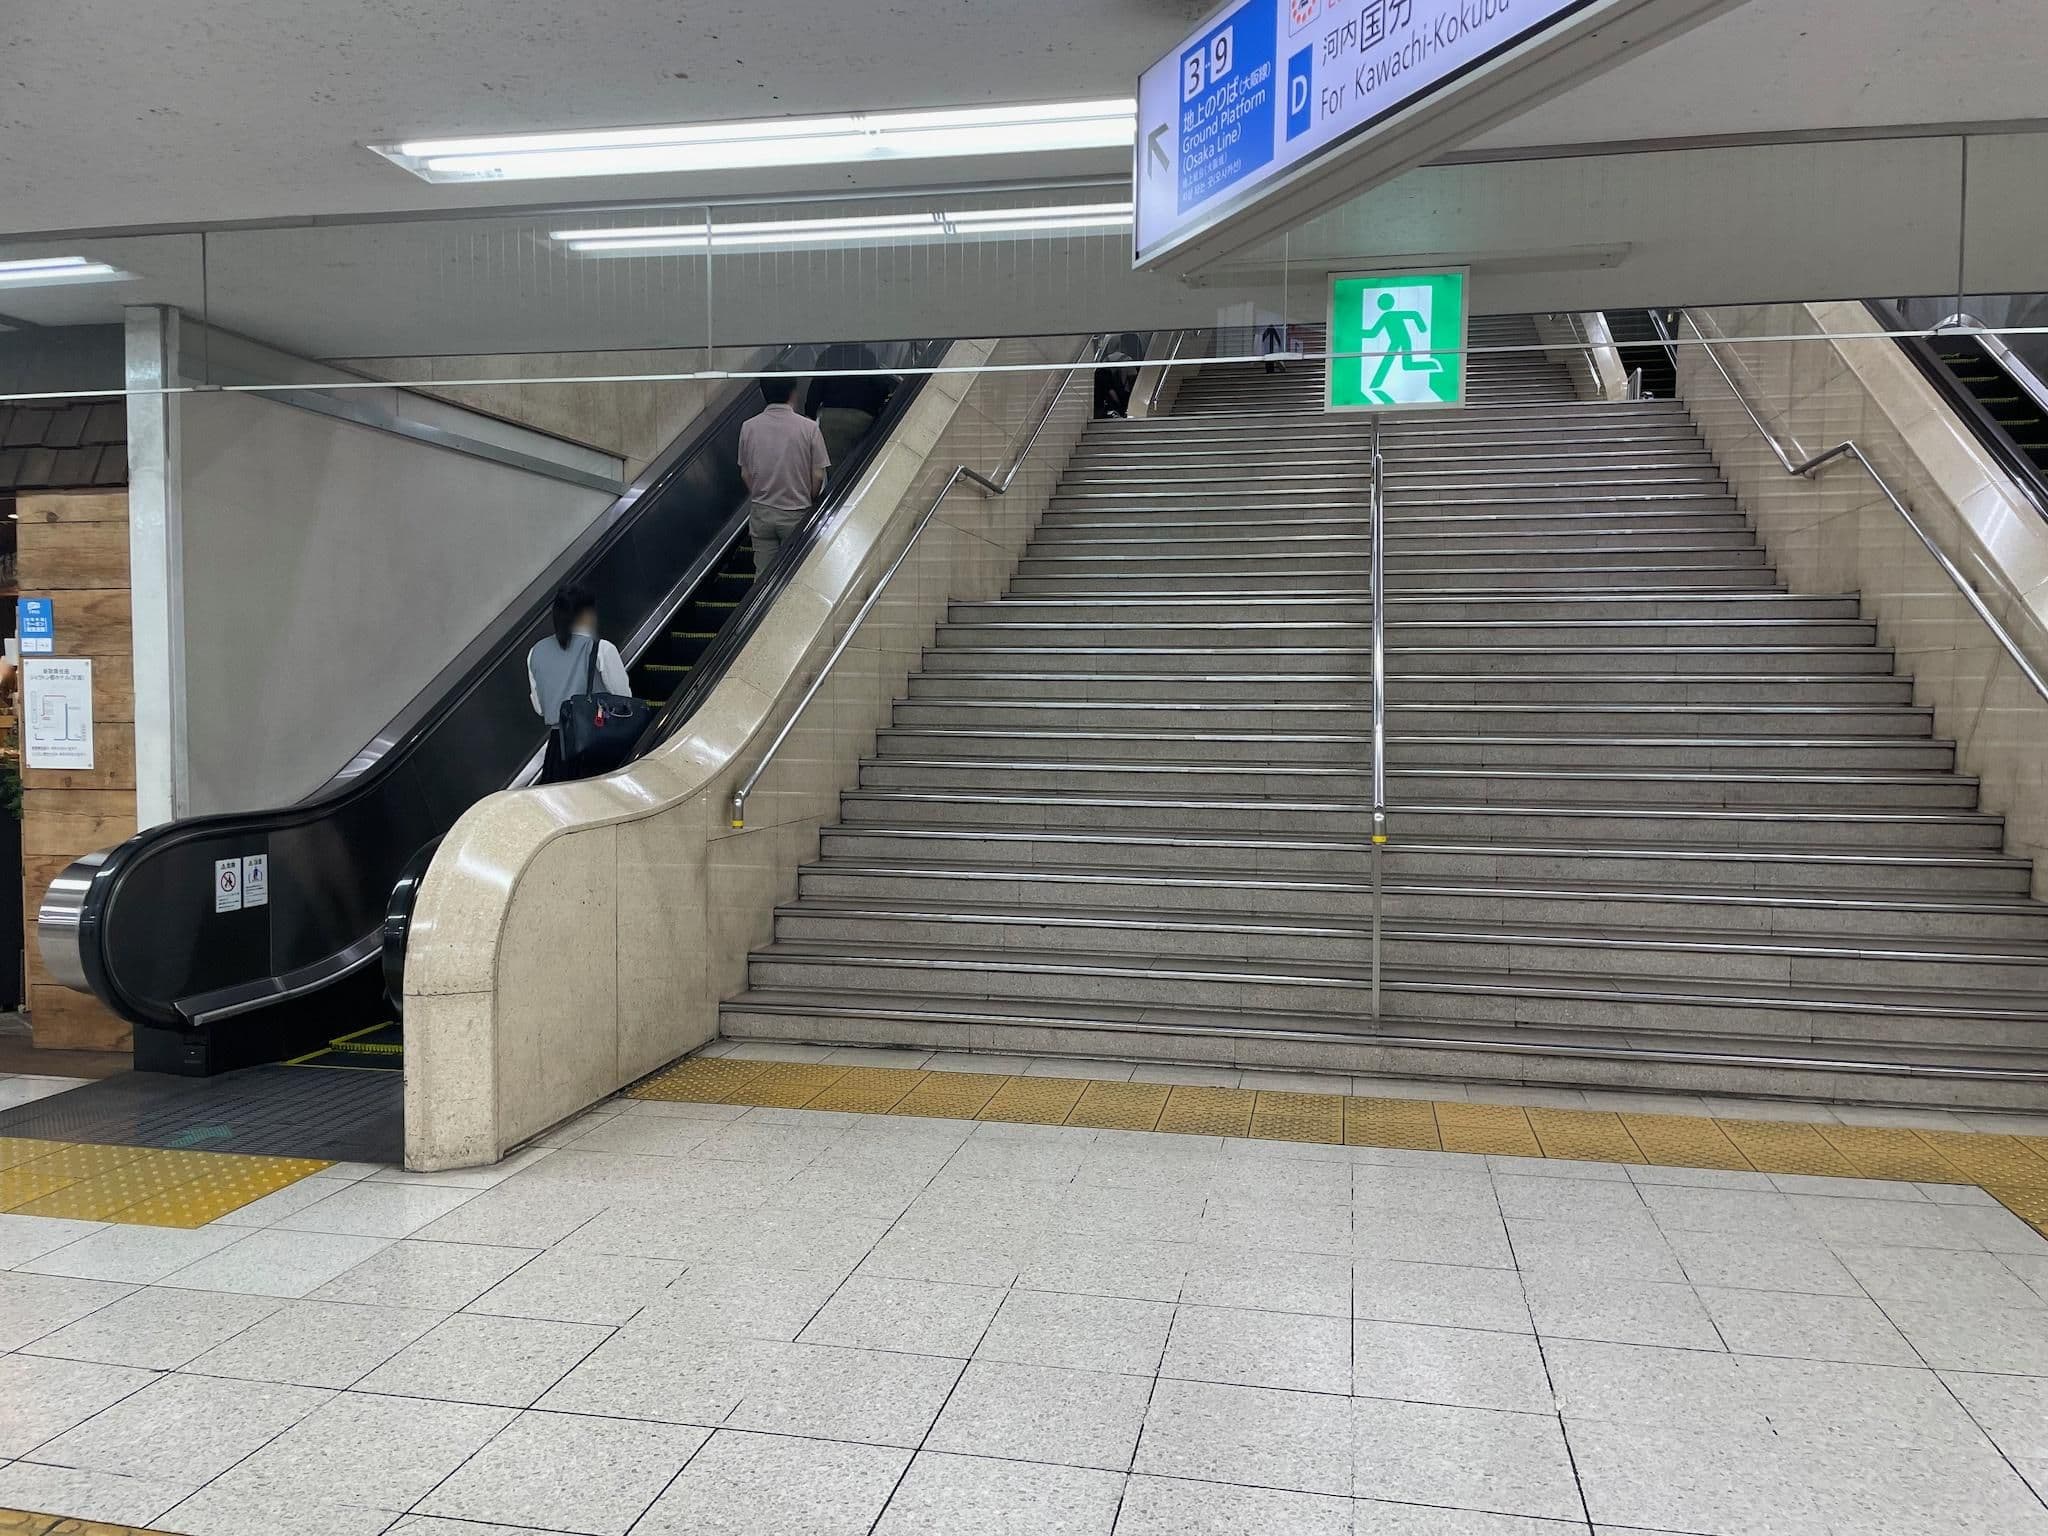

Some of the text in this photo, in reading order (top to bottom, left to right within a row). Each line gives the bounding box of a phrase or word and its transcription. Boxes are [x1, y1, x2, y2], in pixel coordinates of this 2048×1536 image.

[1322, 0, 1412, 66] 河内国分
[1188, 36, 1228, 95] 3 9
[1183, 88, 1265, 154] Ground Platform
[1291, 74, 1308, 116] D
[1321, 83, 1346, 120] For
[1183, 121, 1241, 175] (Osaka Line)
